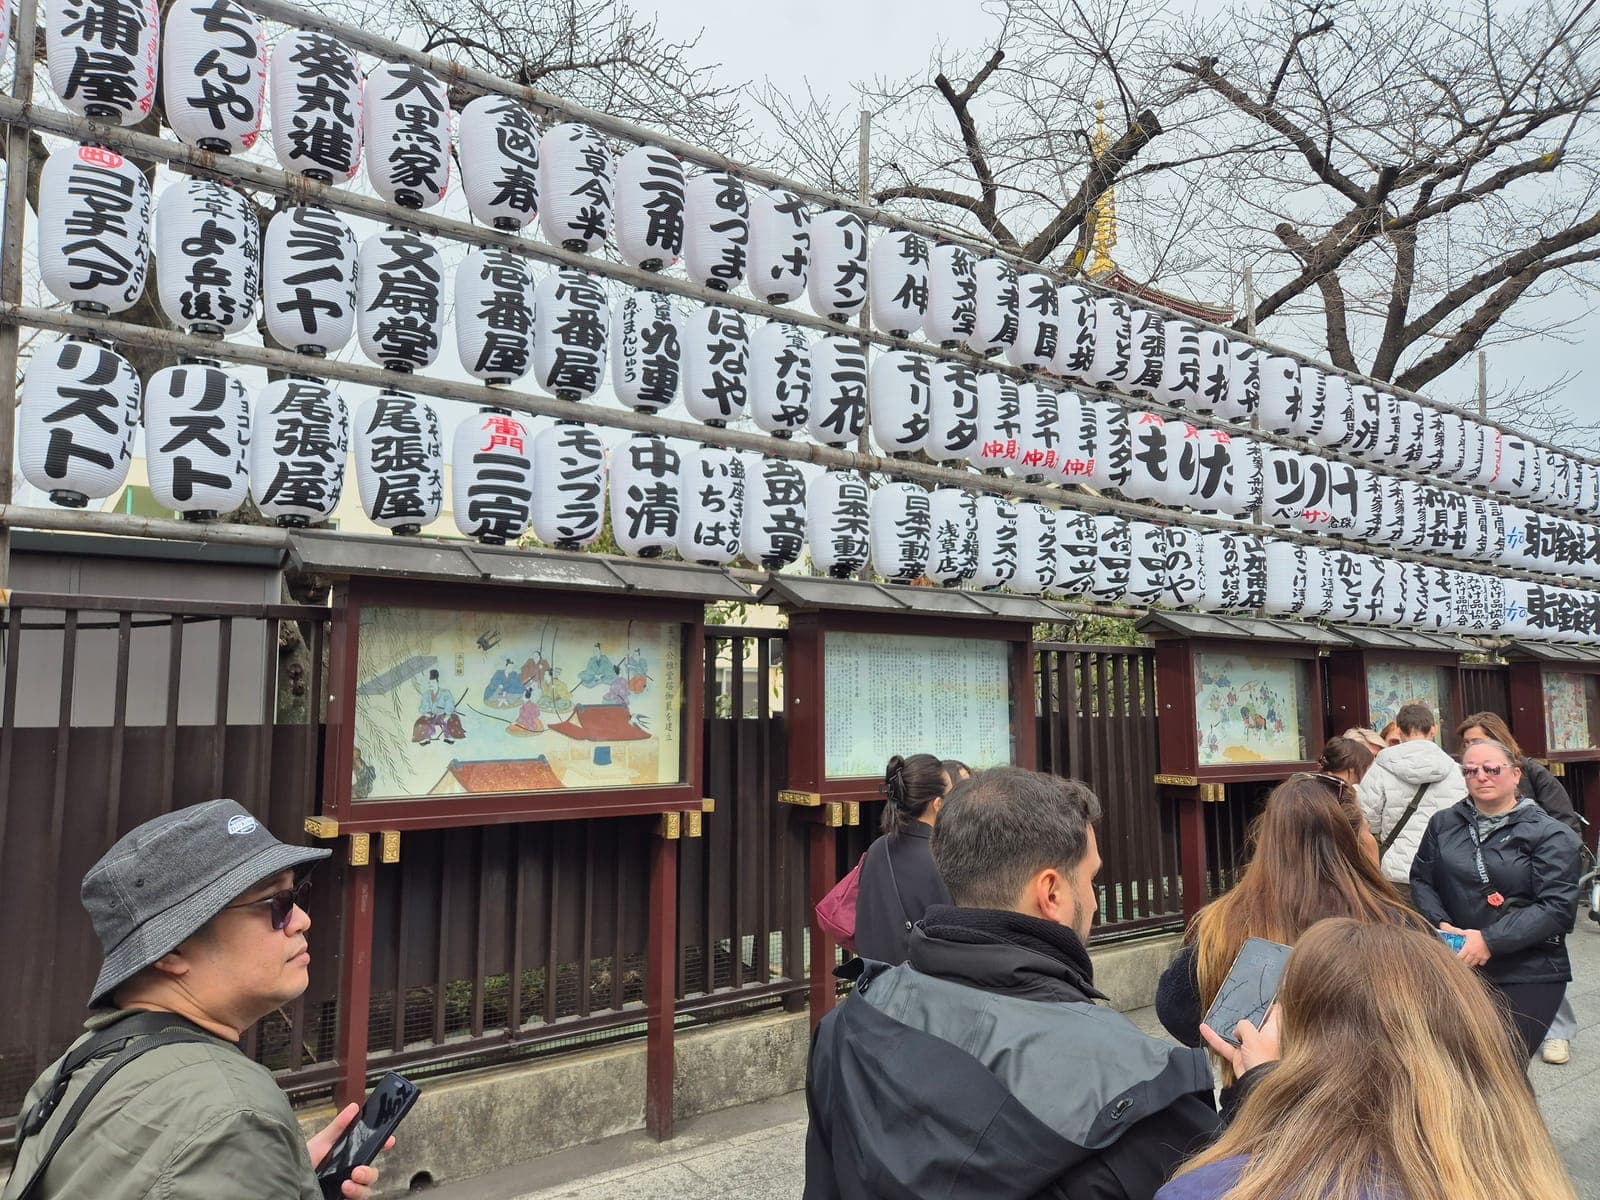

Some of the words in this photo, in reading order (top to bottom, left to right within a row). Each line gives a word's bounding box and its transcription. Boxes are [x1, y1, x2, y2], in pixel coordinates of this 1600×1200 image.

[187, 0, 257, 130] ちんや
[288, 34, 358, 172] 葵丸進
[381, 65, 444, 194] 大黒家
[188, 181, 235, 219] 浅草
[568, 125, 610, 239] 浅草今半
[640, 154, 685, 255] 三角
[365, 234, 440, 366] 文扇堂
[623, 297, 641, 382] あげまんじゅう
[951, 248, 977, 336] 紀文堂
[702, 309, 749, 415] はなや
[896, 355, 930, 444] モリタ
[1130, 313, 1165, 388] 尾張屋
[42, 344, 122, 478] リスト
[159, 369, 232, 501] リスト
[260, 383, 336, 512] 尾張屋
[424, 404, 442, 458] おそば
[481, 415, 527, 456] 雷門
[944, 365, 978, 451] モリタ
[365, 399, 430, 520] 尾張屋
[468, 453, 532, 538] 三定
[557, 429, 602, 542] モンブラン
[626, 439, 680, 539] 中清
[831, 484, 870, 572] 日本不動産
[887, 495, 931, 578] 日本不動産
[936, 520, 960, 573] 浅草店
